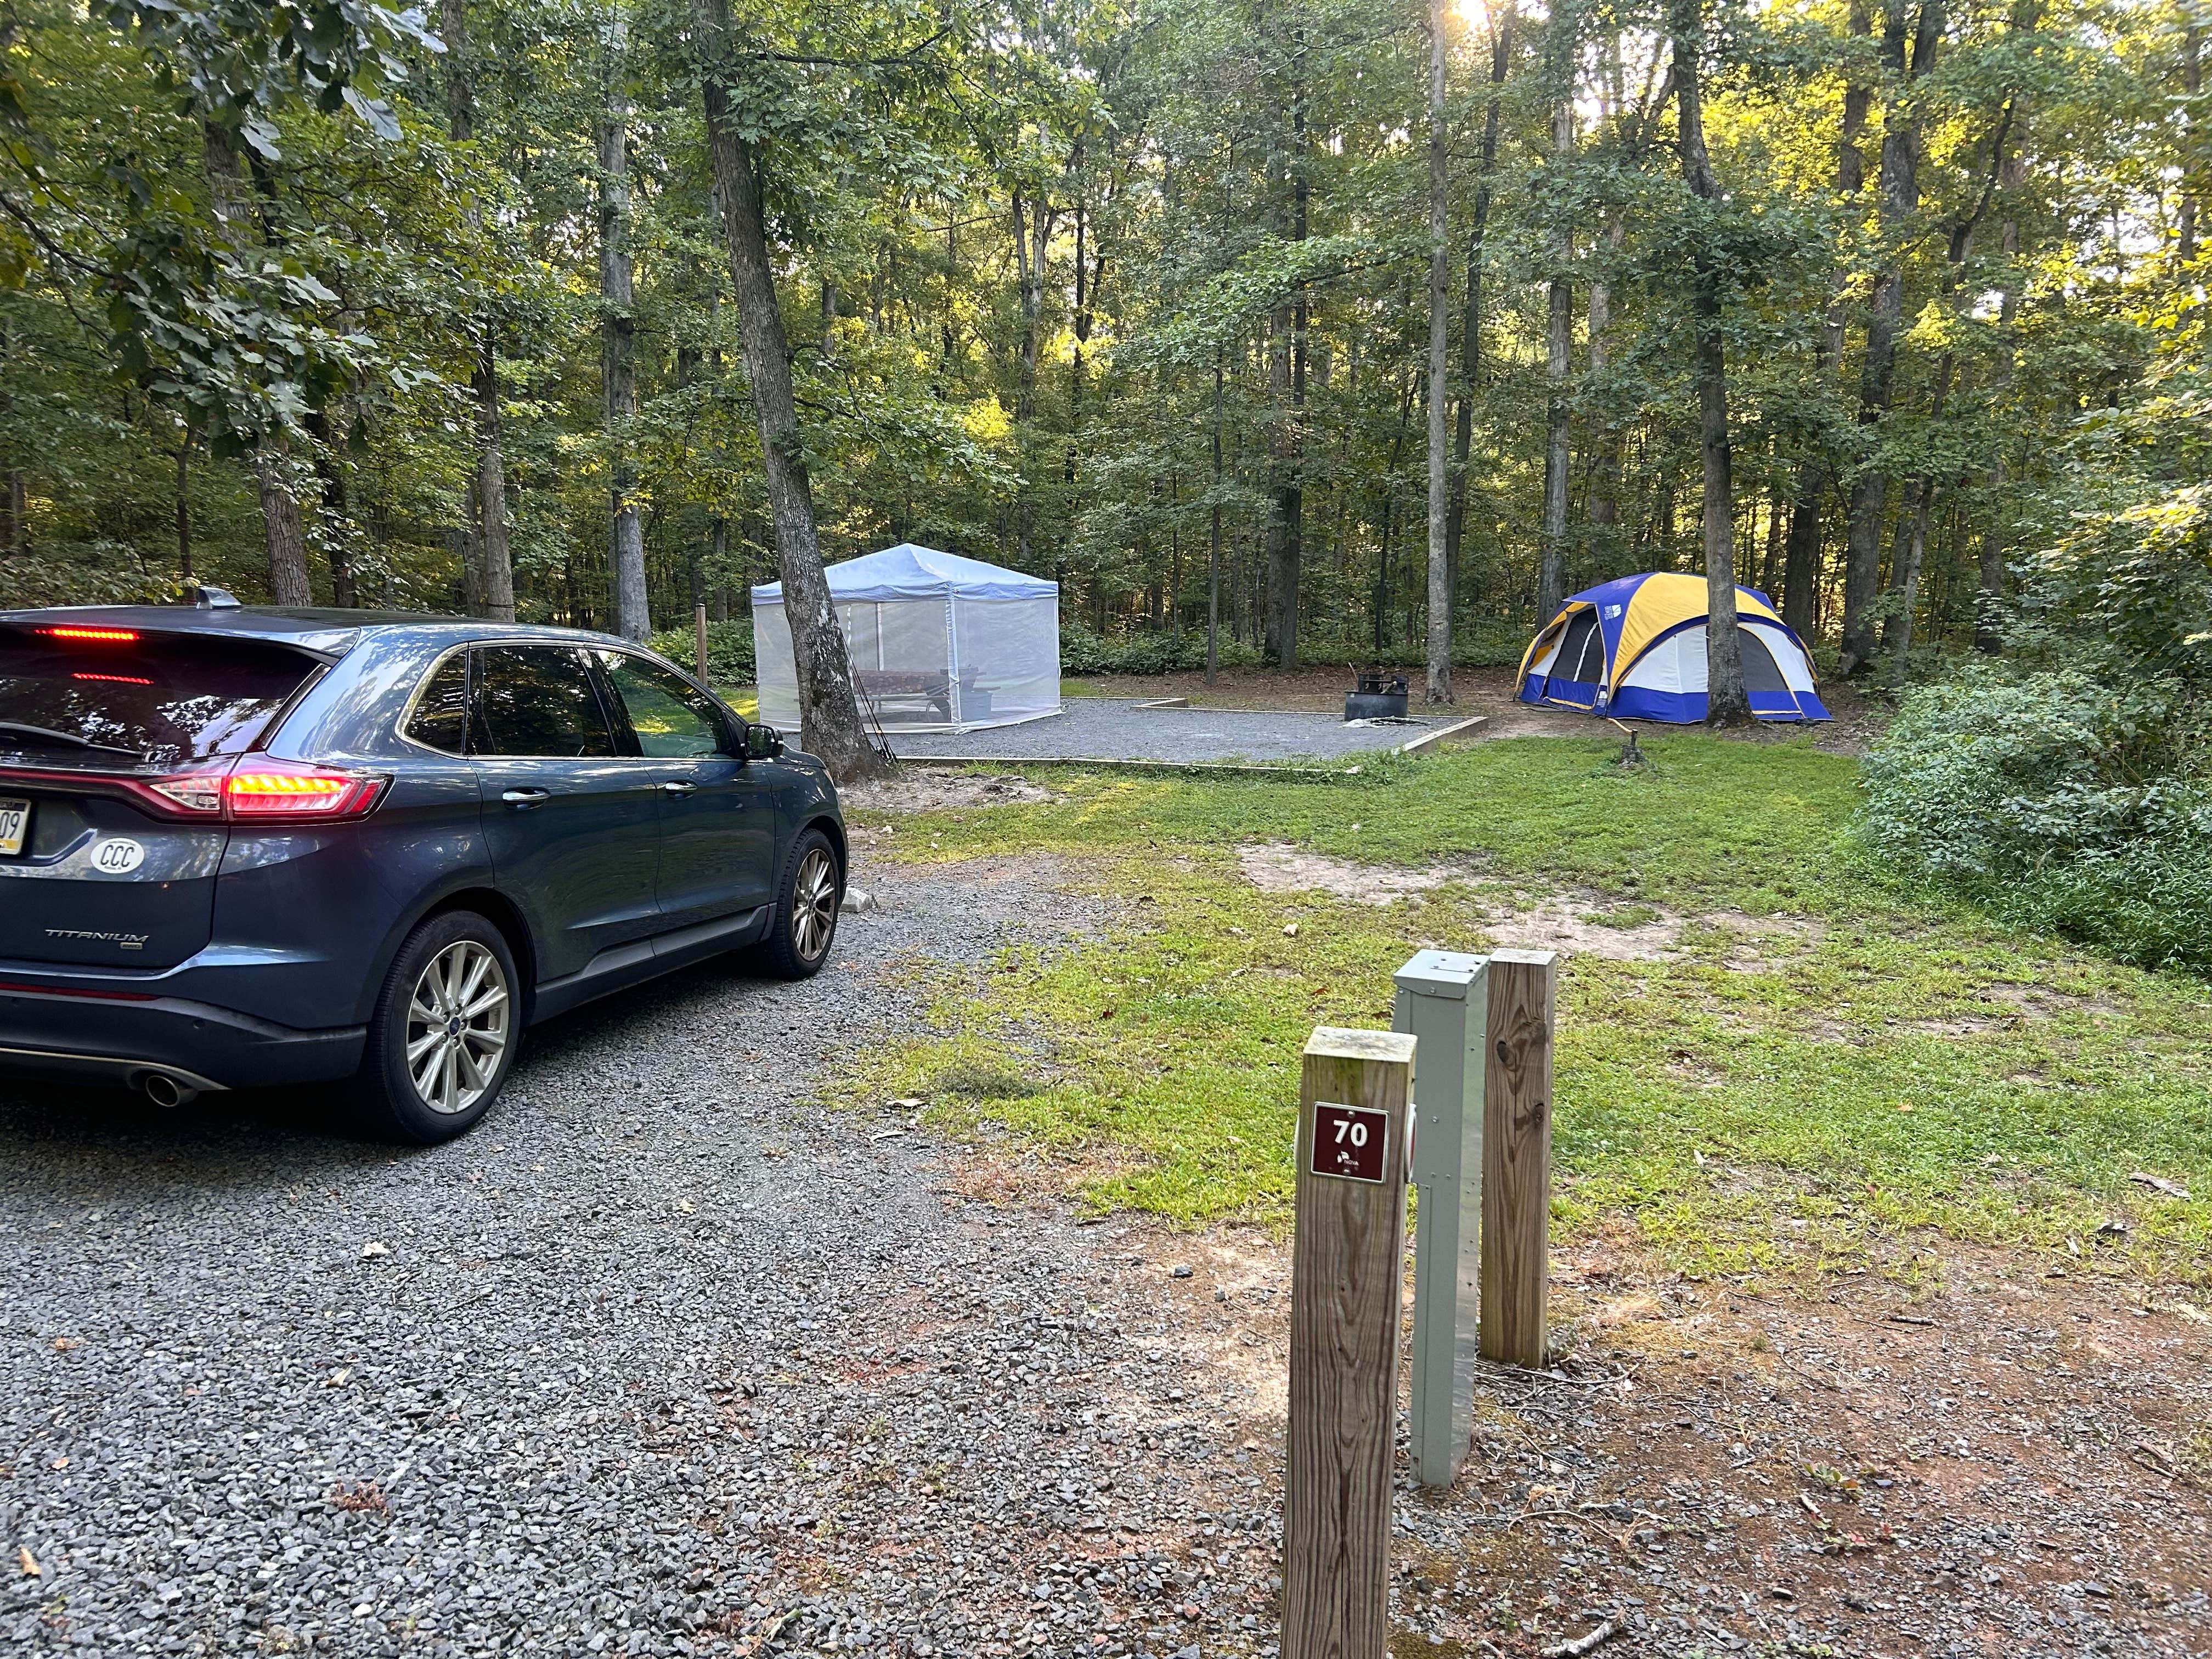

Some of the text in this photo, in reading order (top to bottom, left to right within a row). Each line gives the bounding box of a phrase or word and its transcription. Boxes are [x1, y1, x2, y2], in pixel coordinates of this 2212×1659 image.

[100, 844, 135, 867] CCC
[45, 929, 149, 942] TITANIUM
[1333, 1119, 1368, 1147] 70
